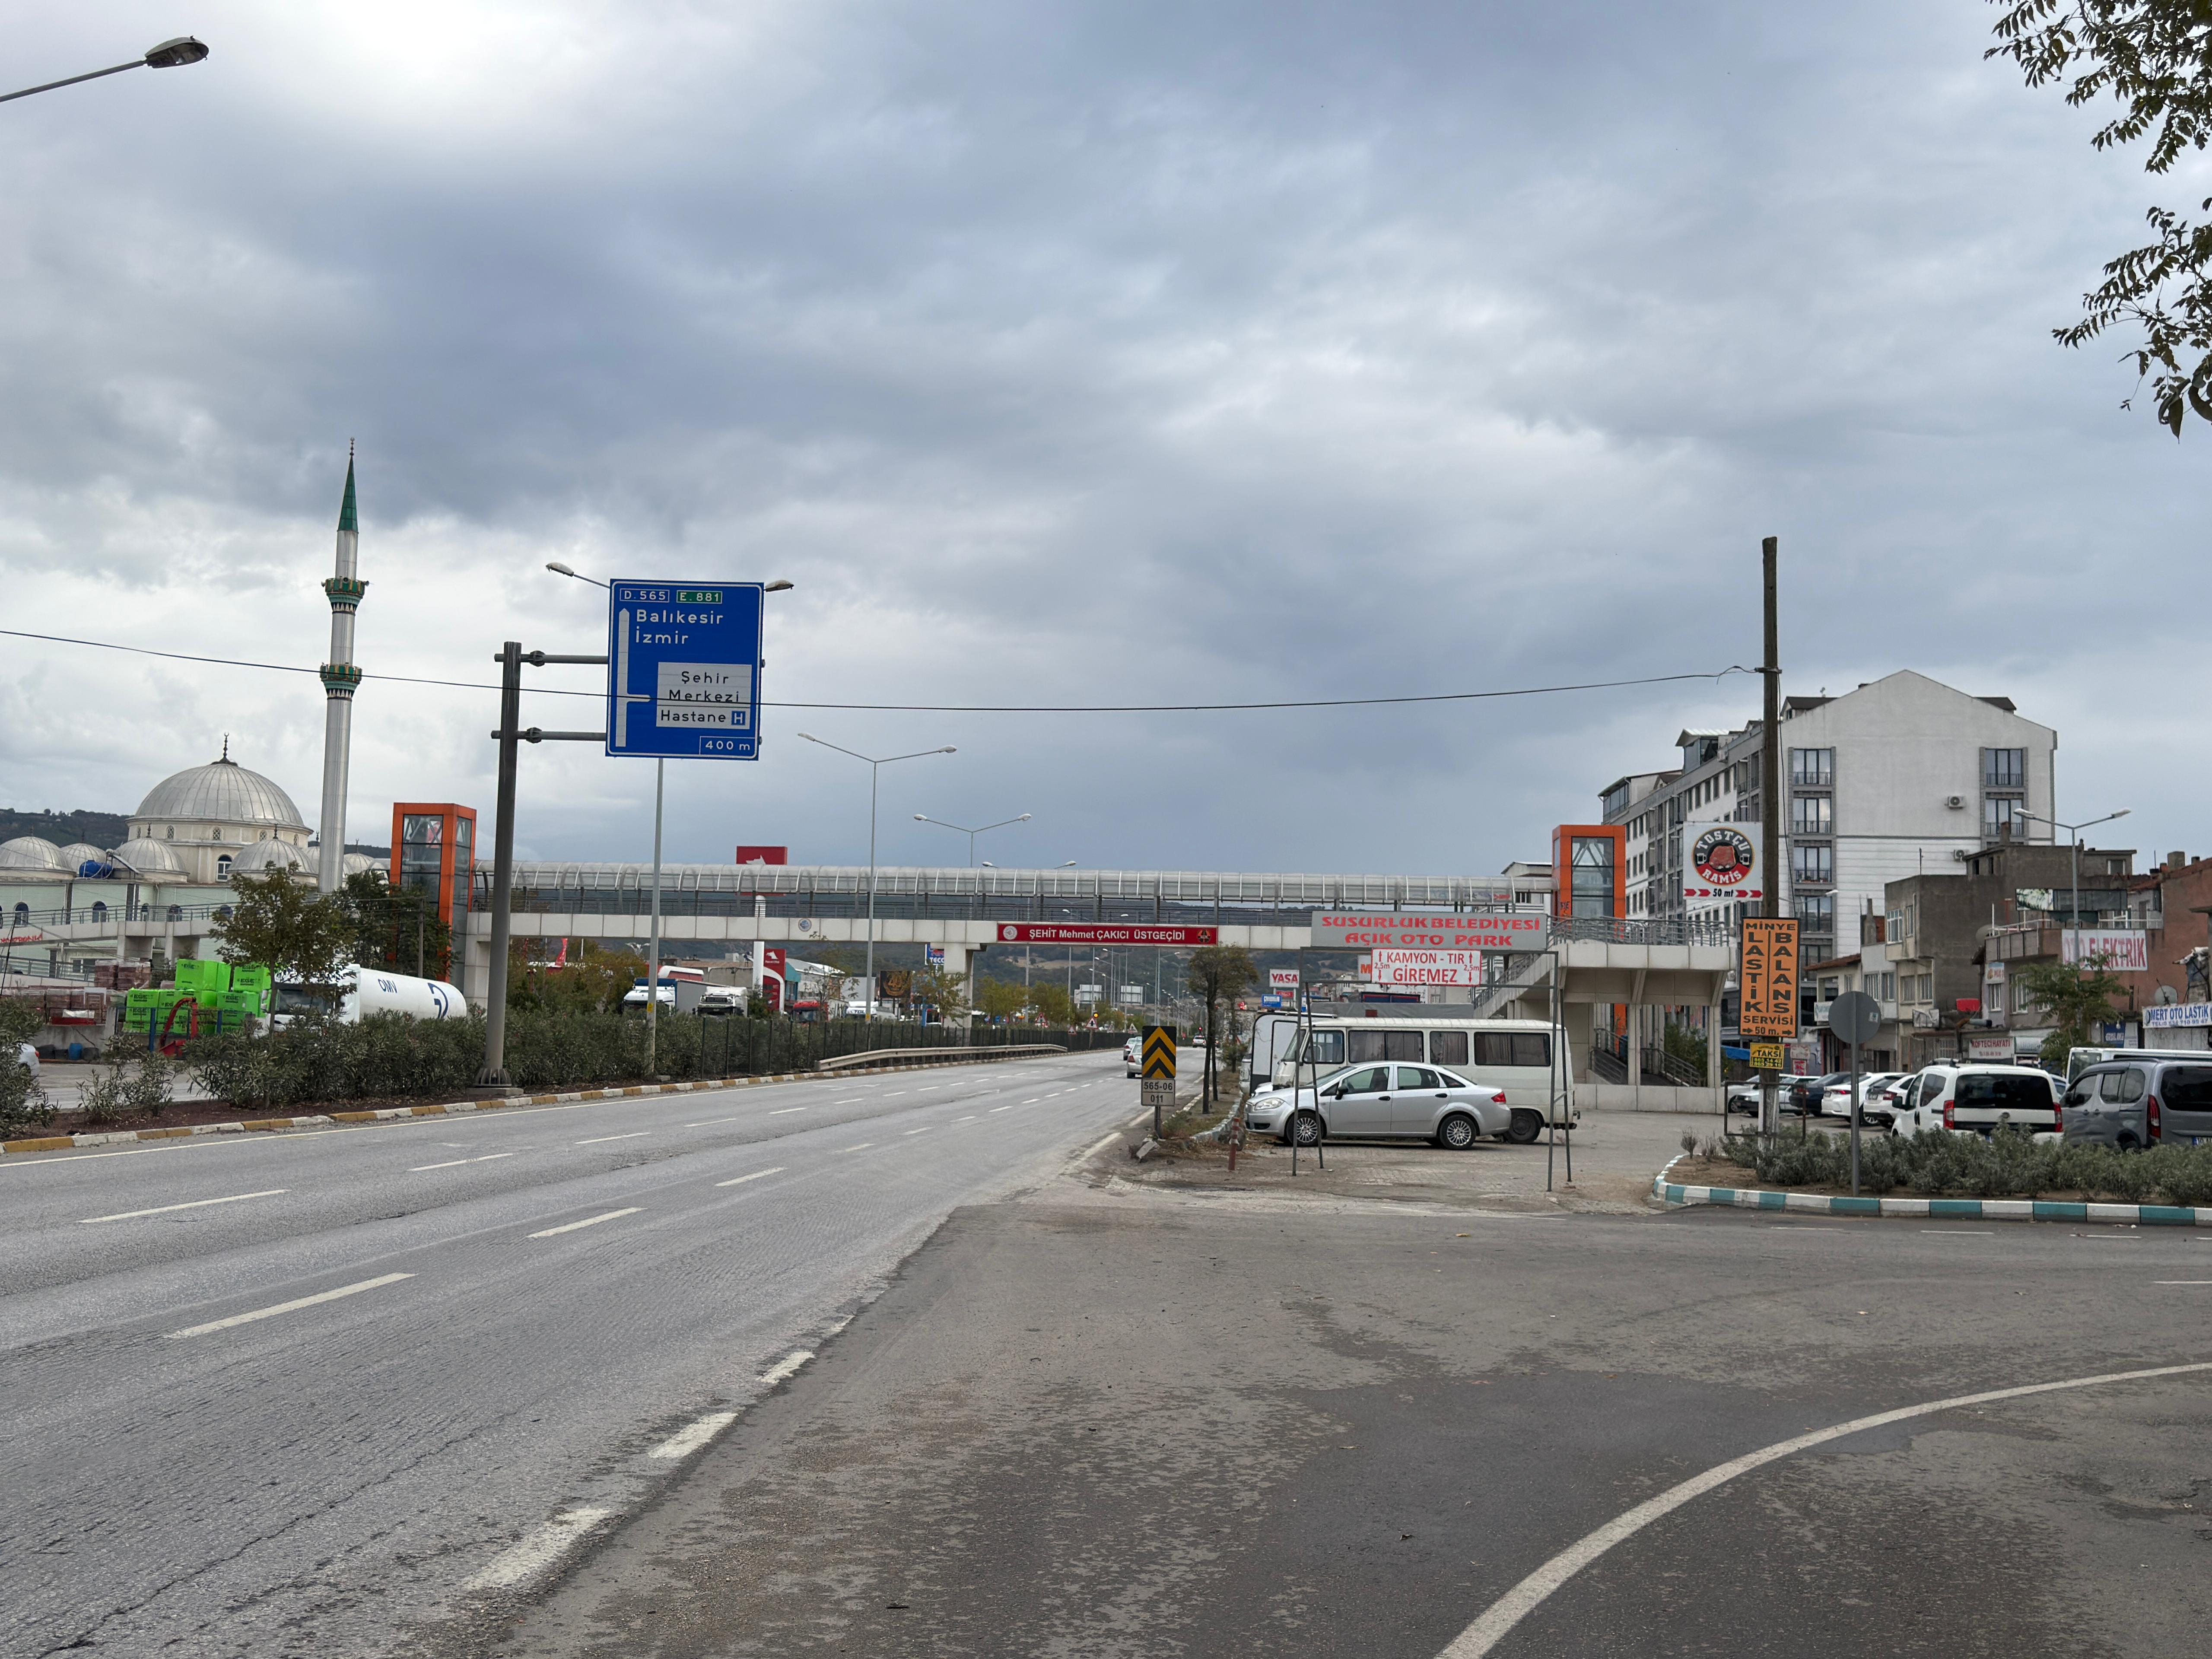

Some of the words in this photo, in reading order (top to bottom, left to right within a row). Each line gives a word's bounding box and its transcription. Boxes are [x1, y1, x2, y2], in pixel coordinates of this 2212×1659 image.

[637, 609, 723, 624] Balıkesir
[636, 626, 689, 644] İzmir
[681, 671, 729, 684] Şehir
[669, 690, 739, 702] Merkezi
[661, 710, 726, 723] Hastane
[705, 741, 734, 750] 400
[1696, 830, 1750, 851] TOSTÇU
[1702, 868, 1742, 884] RAMİS
[1713, 888, 1722, 897] 50
[1322, 916, 1428, 928] SUSURLUK
[1431, 916, 1540, 930] BELEDİYESİ
[1745, 921, 1796, 930] MİNYE
[1030, 928, 1057, 940] ŞEHİT
[1059, 929, 1094, 938] Mehmet
[1096, 930, 1129, 941] ÇAKICI
[1134, 929, 1185, 941] ÜSTGEÇİDİ
[1345, 932, 1393, 946] AÇIK
[1400, 934, 1444, 945] OTO
[1455, 934, 1512, 947] PARK
[1387, 952, 1437, 964] KAMYON
[1447, 953, 1465, 964] TIR
[1271, 973, 1298, 983] YASA
[1393, 965, 1457, 983] GİREMEZ
[1745, 931, 1765, 1013] LASTİK
[1772, 932, 1792, 1014] BALANS
[378, 979, 397, 993] OMV
[2151, 1009, 2168, 1020] MERT
[2170, 1007, 2183, 1020] OTO
[2185, 1005, 2209, 1019] LASTİK
[1743, 1014, 1793, 1025] SERVİSİ
[1755, 1026, 1766, 1035] 50
[1144, 1082, 1173, 1090] 565-06
[1150, 1094, 1163, 1103] 011
